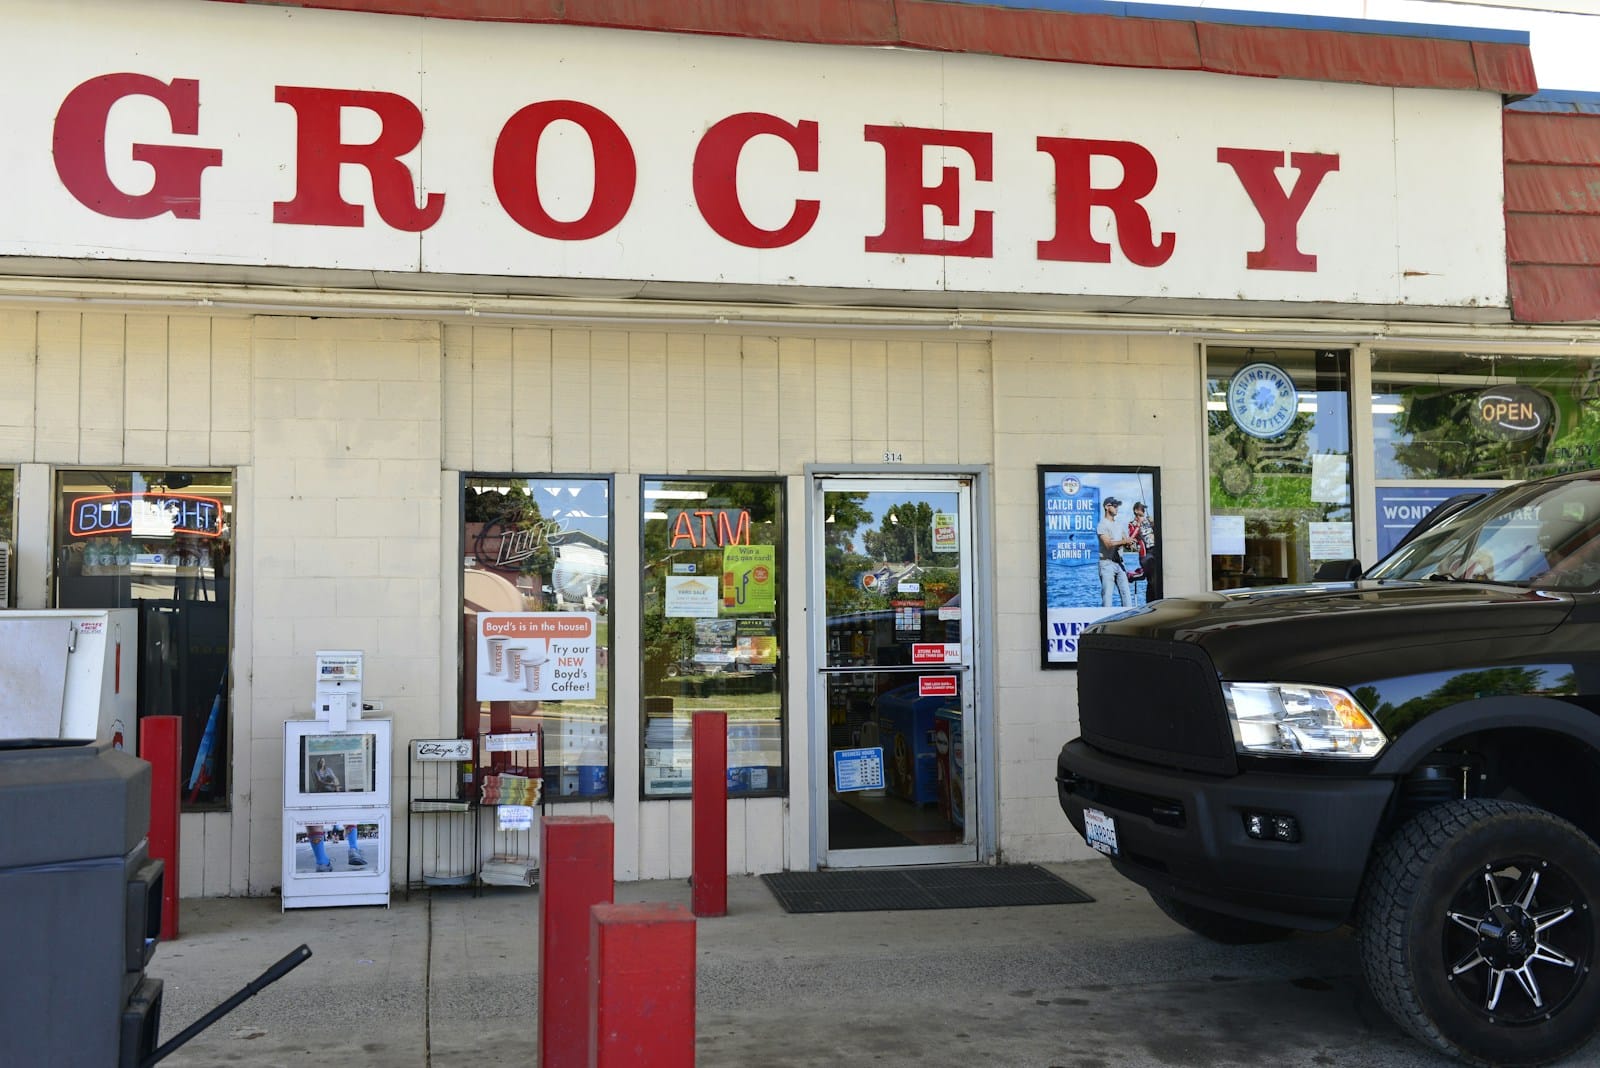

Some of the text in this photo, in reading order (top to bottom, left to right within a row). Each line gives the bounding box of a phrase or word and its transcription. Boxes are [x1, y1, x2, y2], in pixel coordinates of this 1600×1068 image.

[53, 72, 1340, 272] GROCERY
[1236, 370, 1289, 415] WASHINGTON'S
[1251, 406, 1288, 429] LOTTERY
[1482, 403, 1533, 420] OPEN
[884, 453, 902, 462] 314
[1047, 500, 1073, 510] CATCH
[1383, 505, 1436, 519] WOND
[79, 498, 214, 530] BUD IGHT
[671, 511, 750, 548] ATM
[1048, 515, 1070, 530] WIN
[1052, 550, 1082, 559] EARNING
[486, 622, 588, 633] Boyd's is in the house!
[552, 645, 568, 655] Try
[1048, 638, 1080, 652] FIS
[558, 657, 583, 666] NEW
[554, 669, 587, 680] Boyd's
